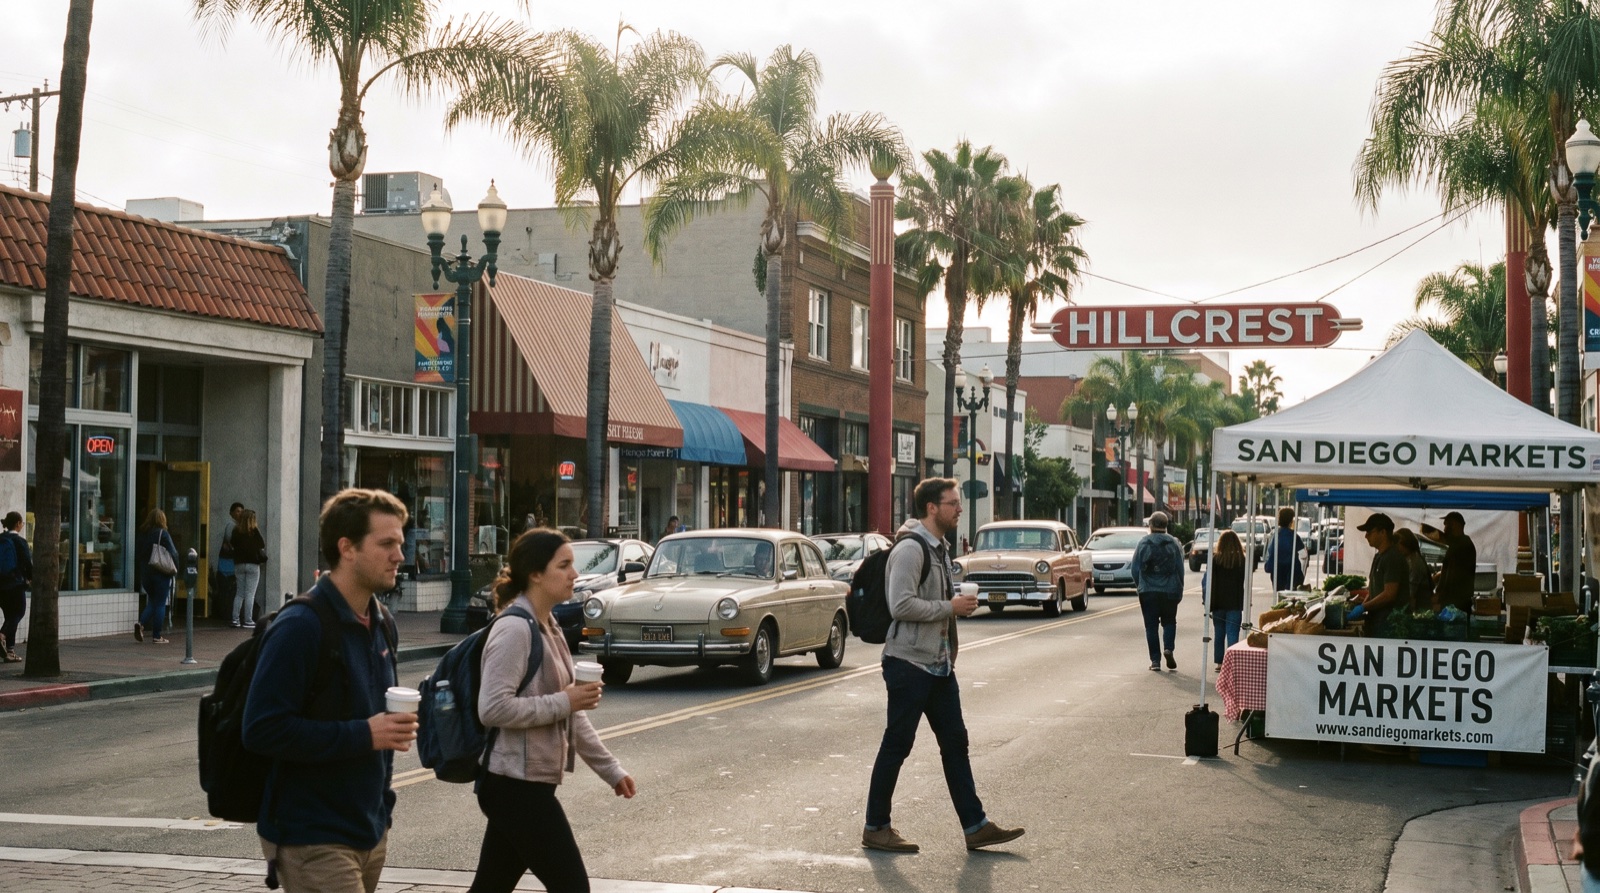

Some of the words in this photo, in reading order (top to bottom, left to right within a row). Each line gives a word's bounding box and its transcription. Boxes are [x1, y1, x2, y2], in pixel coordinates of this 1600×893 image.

[1068, 307, 1323, 345] HILLCREST
[87, 438, 114, 453] OPEN
[1238, 439, 1302, 463] SAN
[1315, 440, 1417, 466] DIEGO
[1429, 443, 1586, 470] MARKETS
[1317, 642, 1384, 677] SAN
[1397, 646, 1496, 683] DIEGO
[1318, 680, 1493, 724] MARKETS
[1316, 724, 1493, 744] www.sandiegomarkets.com
